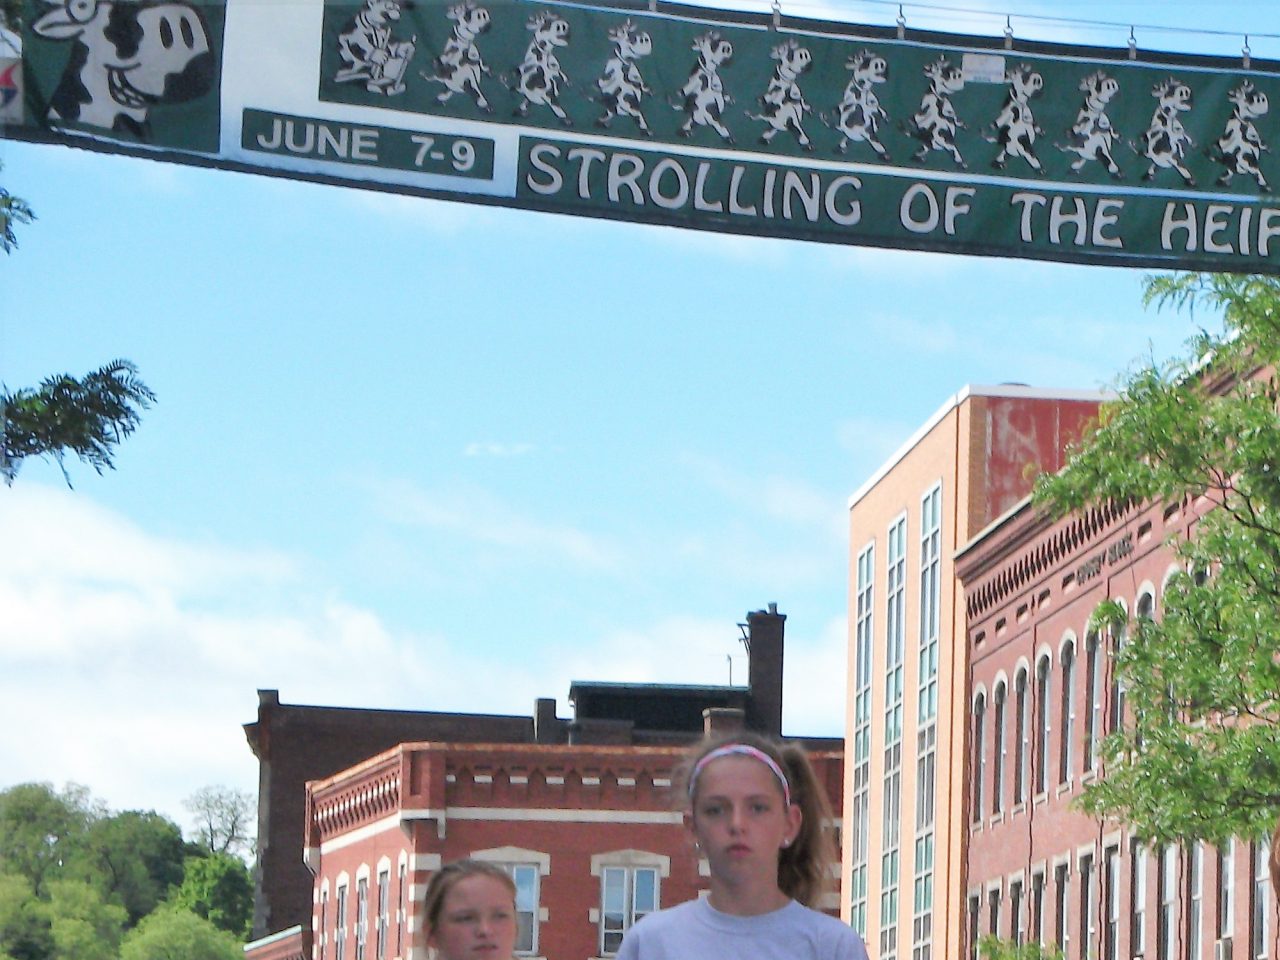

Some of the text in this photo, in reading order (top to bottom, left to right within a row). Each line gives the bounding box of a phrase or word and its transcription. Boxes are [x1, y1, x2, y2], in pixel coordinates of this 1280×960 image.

[257, 118, 476, 172] JUNE 7-9
[526, 146, 863, 226] STROLLING
[900, 183, 976, 235] OF
[1012, 193, 1124, 248] THE
